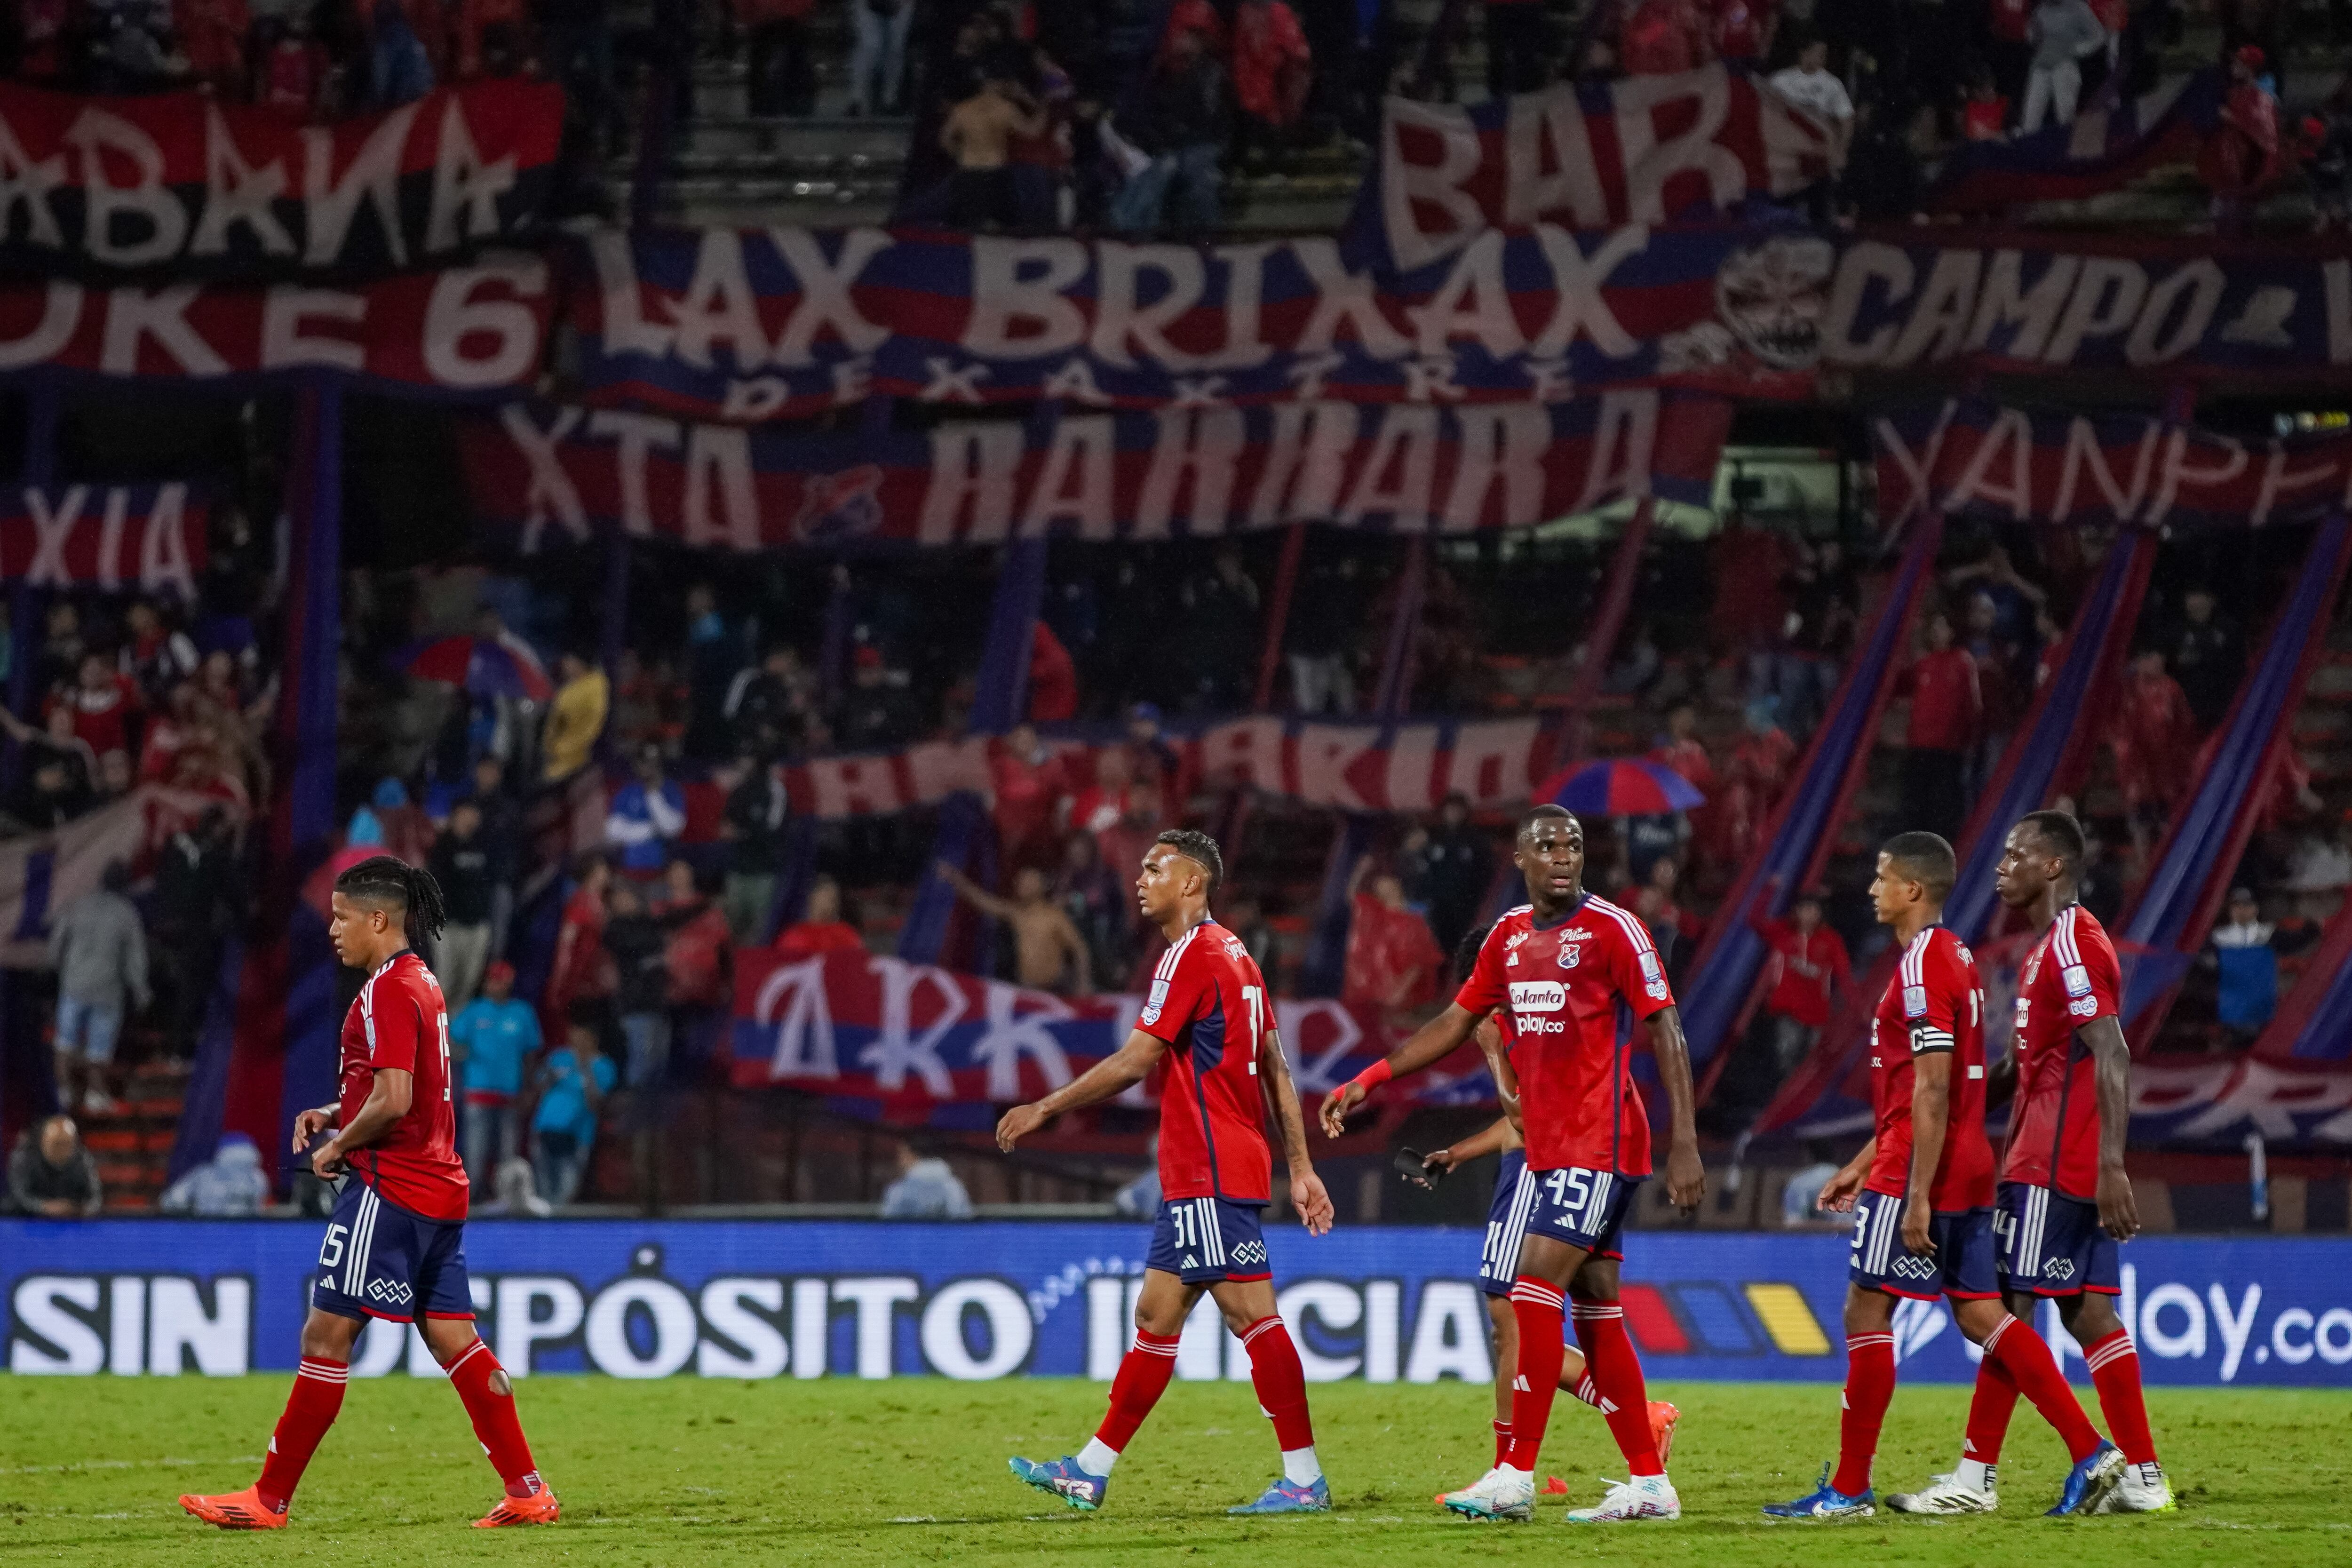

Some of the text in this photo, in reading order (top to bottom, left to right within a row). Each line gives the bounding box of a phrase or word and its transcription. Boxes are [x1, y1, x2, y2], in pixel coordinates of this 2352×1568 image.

[421, 245, 548, 388] 6
[1820, 240, 2227, 369] CAMPO
[1558, 927, 1593, 944] Pilsen
[1516, 1013, 1564, 1036] play.co
[1911, 1028, 1924, 1052] C
[1545, 1166, 1592, 1210] 45
[1171, 1204, 1197, 1249] 31
[9, 1275, 250, 1377] SIN
